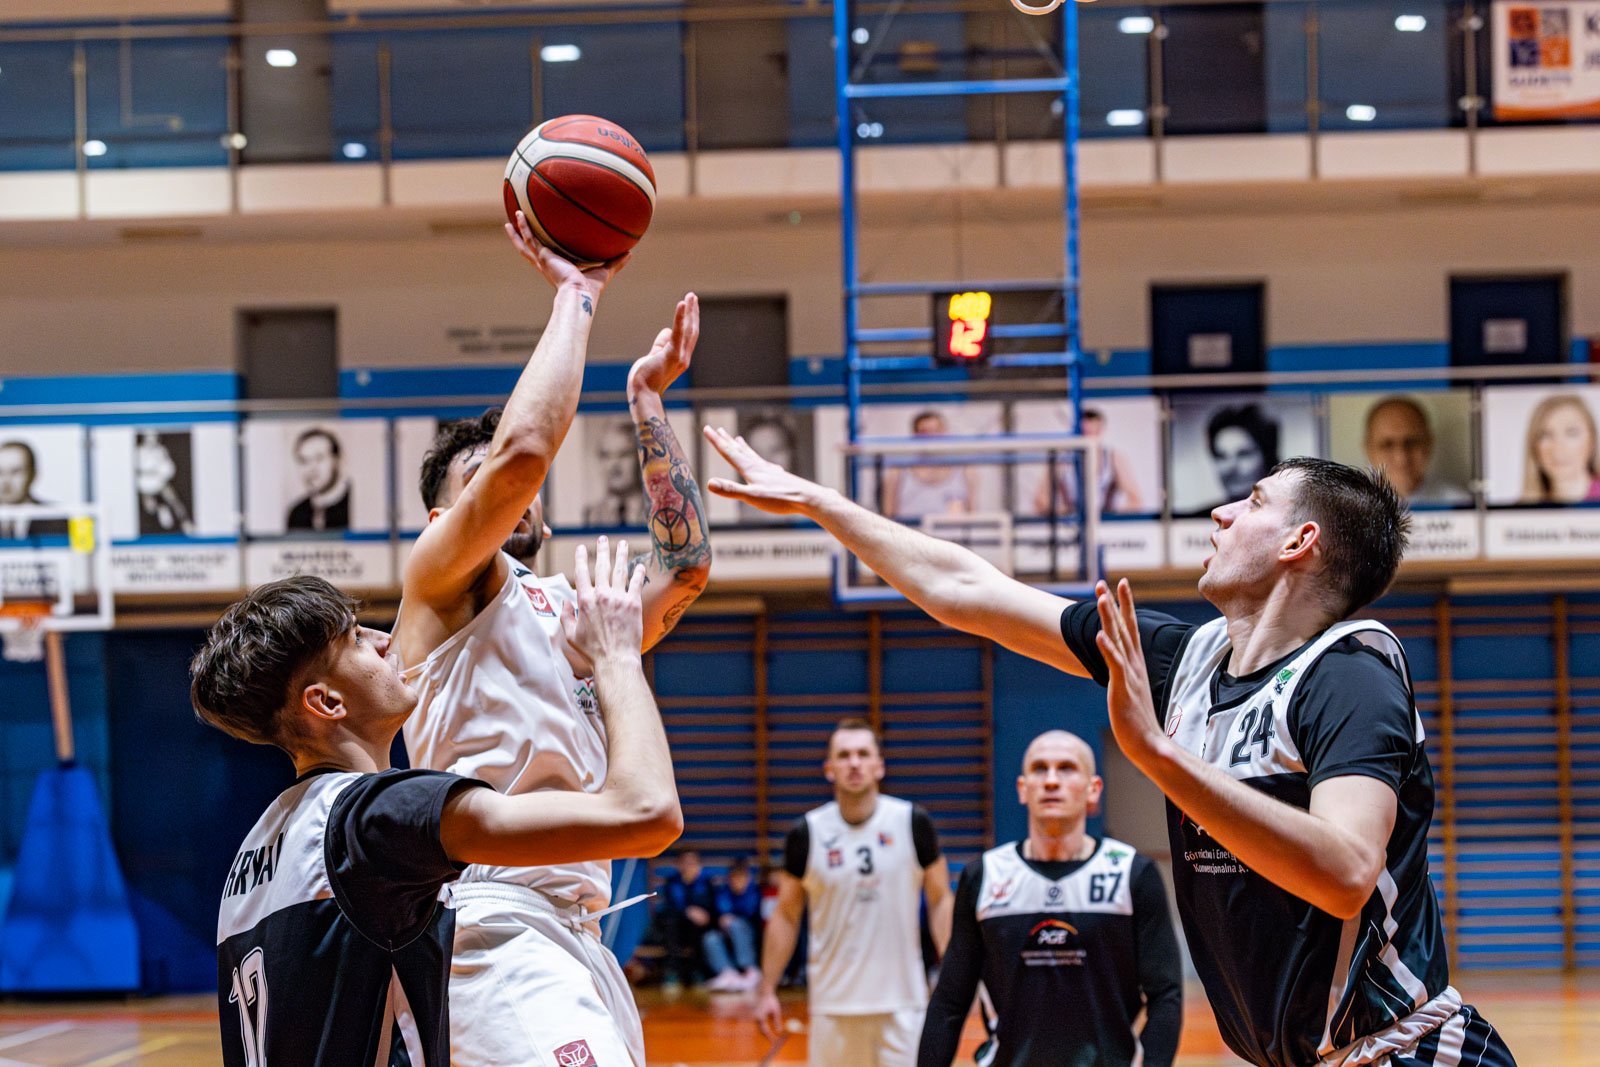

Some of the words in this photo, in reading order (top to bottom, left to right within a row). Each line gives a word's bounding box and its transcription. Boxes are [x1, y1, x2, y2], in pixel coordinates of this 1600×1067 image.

[1229, 700, 1275, 768] 24
[856, 846, 875, 876] 3
[1089, 872, 1123, 904] 67
[229, 946, 268, 1067] 17
